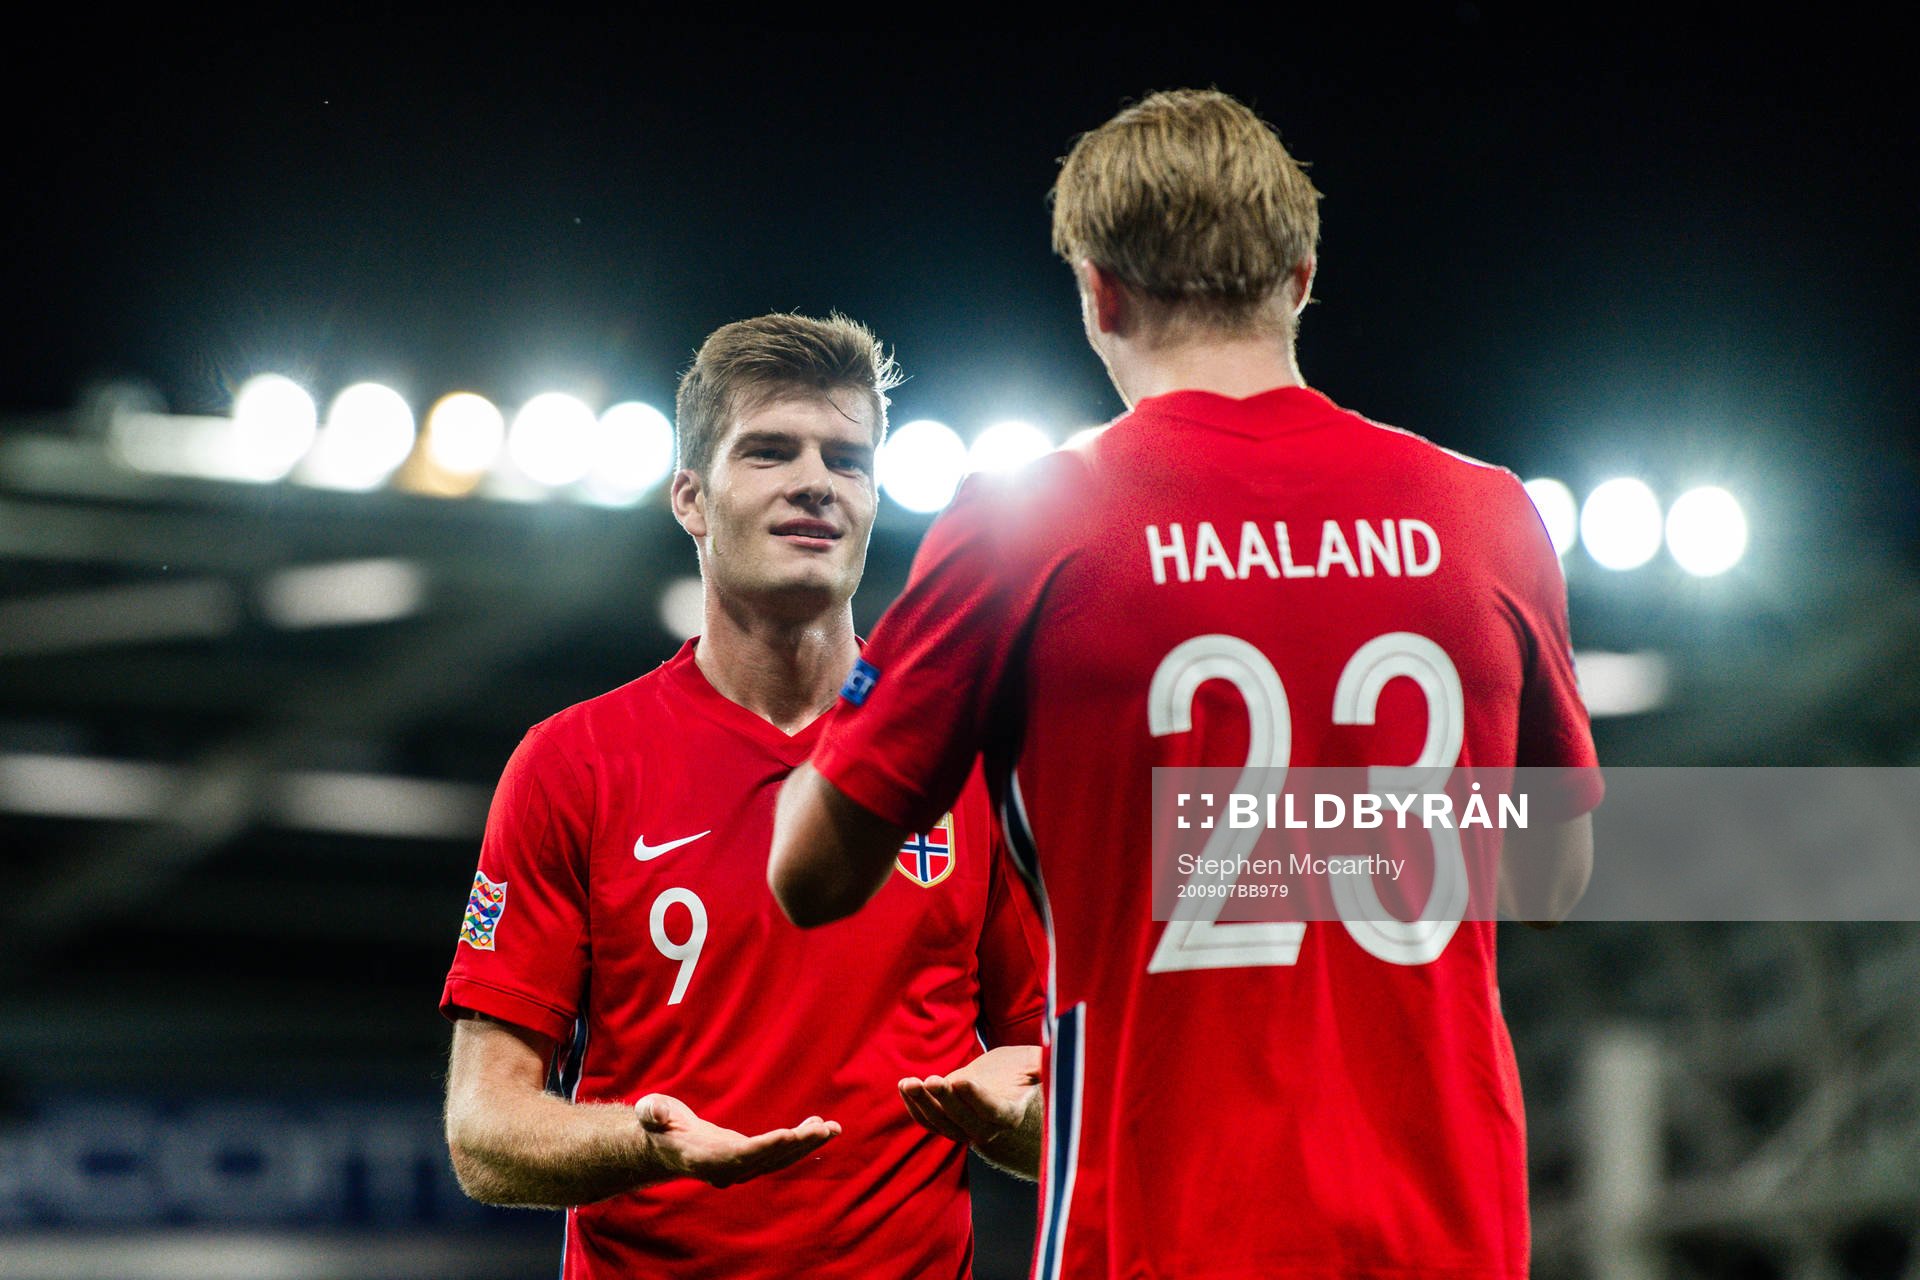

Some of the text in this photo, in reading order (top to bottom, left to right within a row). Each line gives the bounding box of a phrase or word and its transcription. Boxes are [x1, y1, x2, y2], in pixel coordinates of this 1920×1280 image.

[1145, 519, 1442, 584] HAALAND
[1146, 631, 1469, 974] 23
[649, 886, 709, 1006] 9
